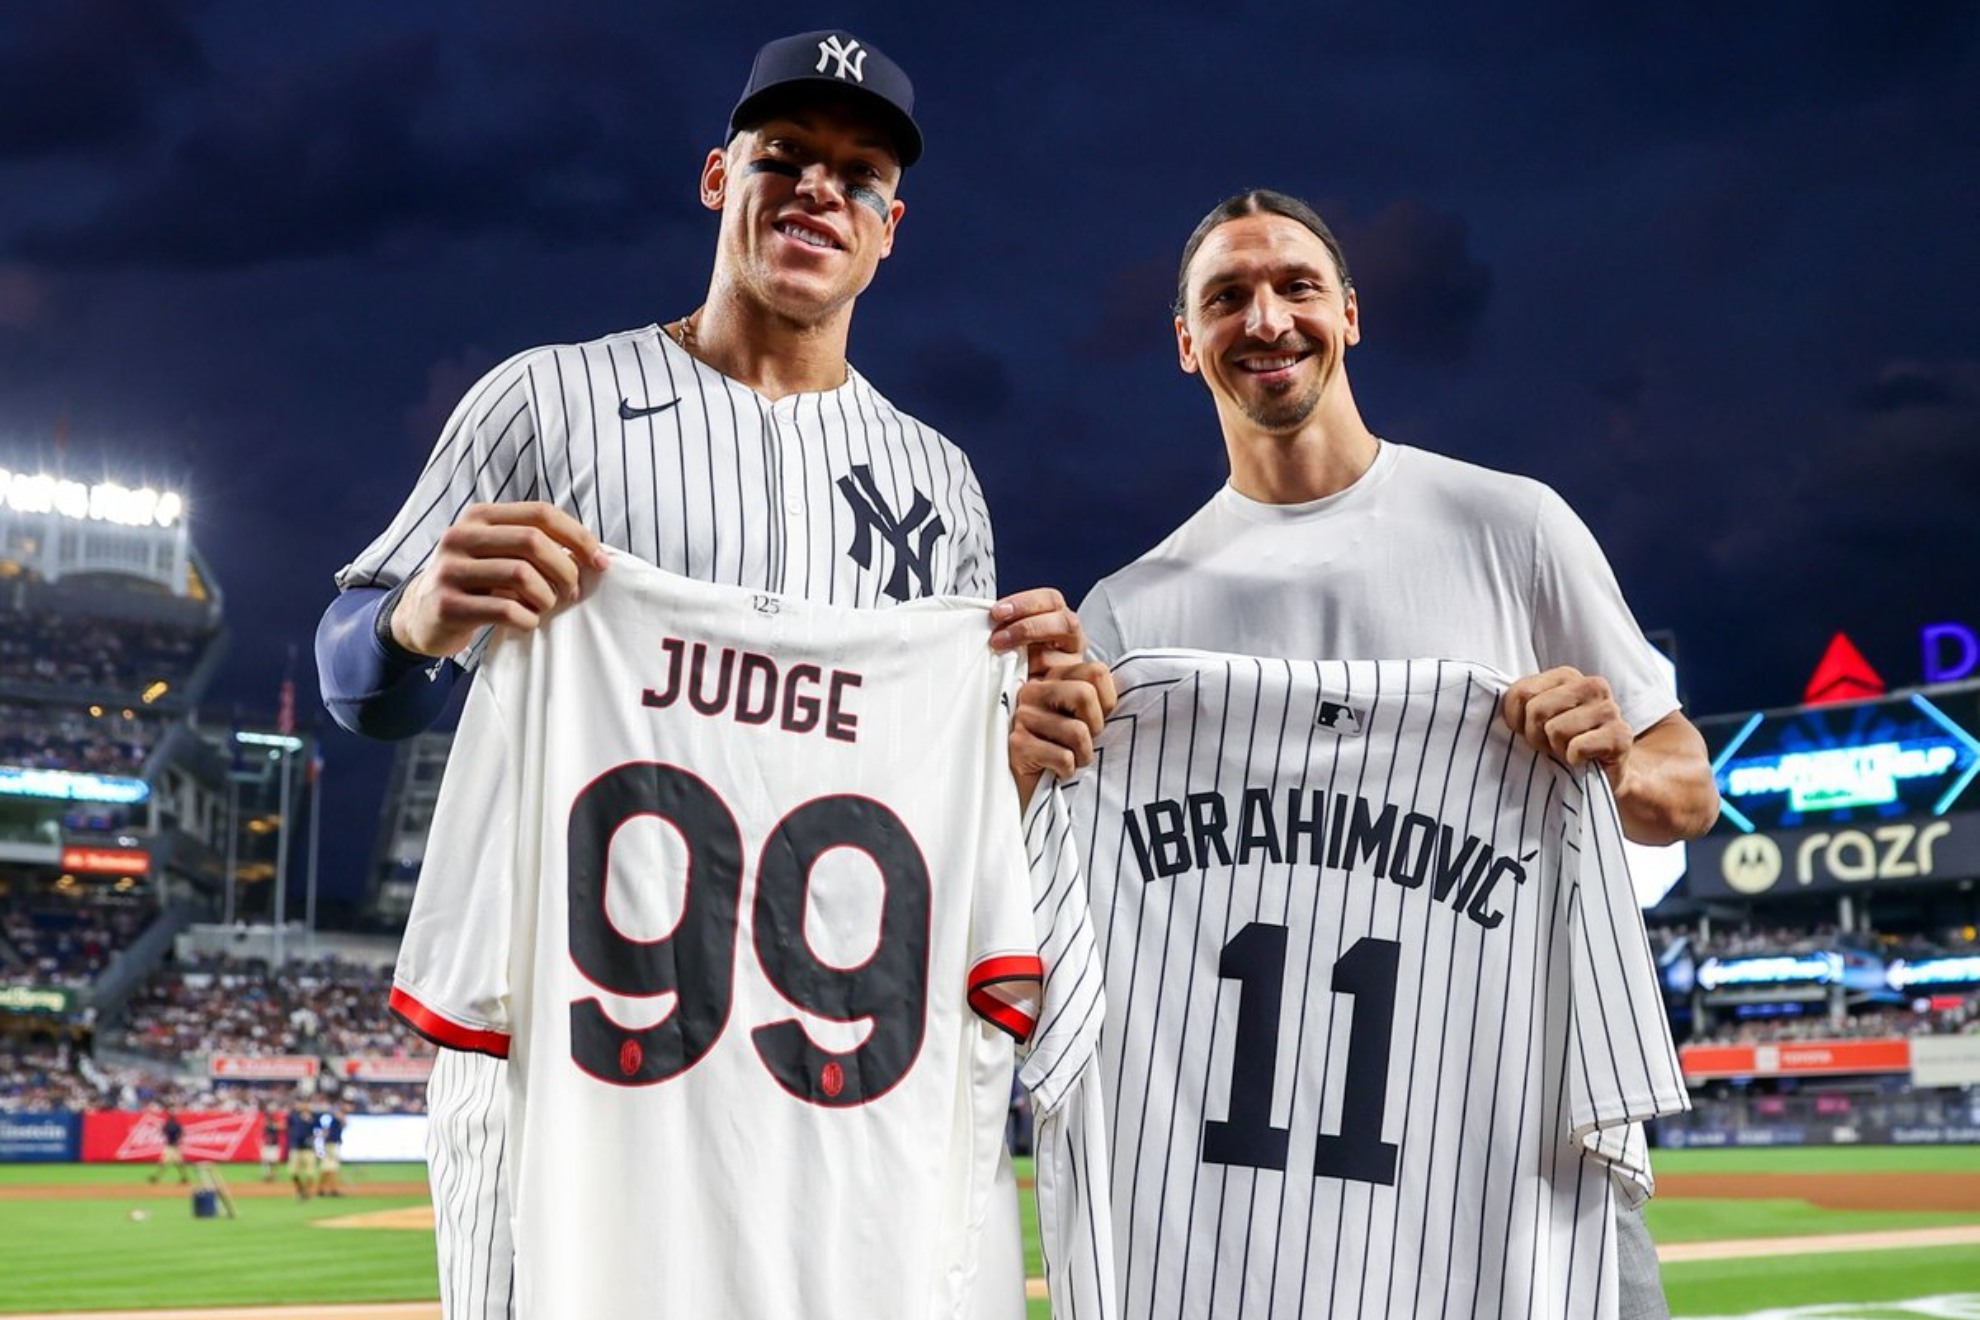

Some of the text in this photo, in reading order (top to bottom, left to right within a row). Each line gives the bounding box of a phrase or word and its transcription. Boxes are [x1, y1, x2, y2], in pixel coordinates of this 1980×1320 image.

[815, 34, 867, 83] NY
[836, 464, 947, 601] NY
[752, 595, 781, 614] 125
[641, 637, 863, 743] JUDGE
[1123, 788, 1538, 930] IBRAHIMOVIĆ
[1796, 821, 1951, 885] razr
[567, 760, 932, 1108] 99
[1202, 922, 1401, 1187] 11
